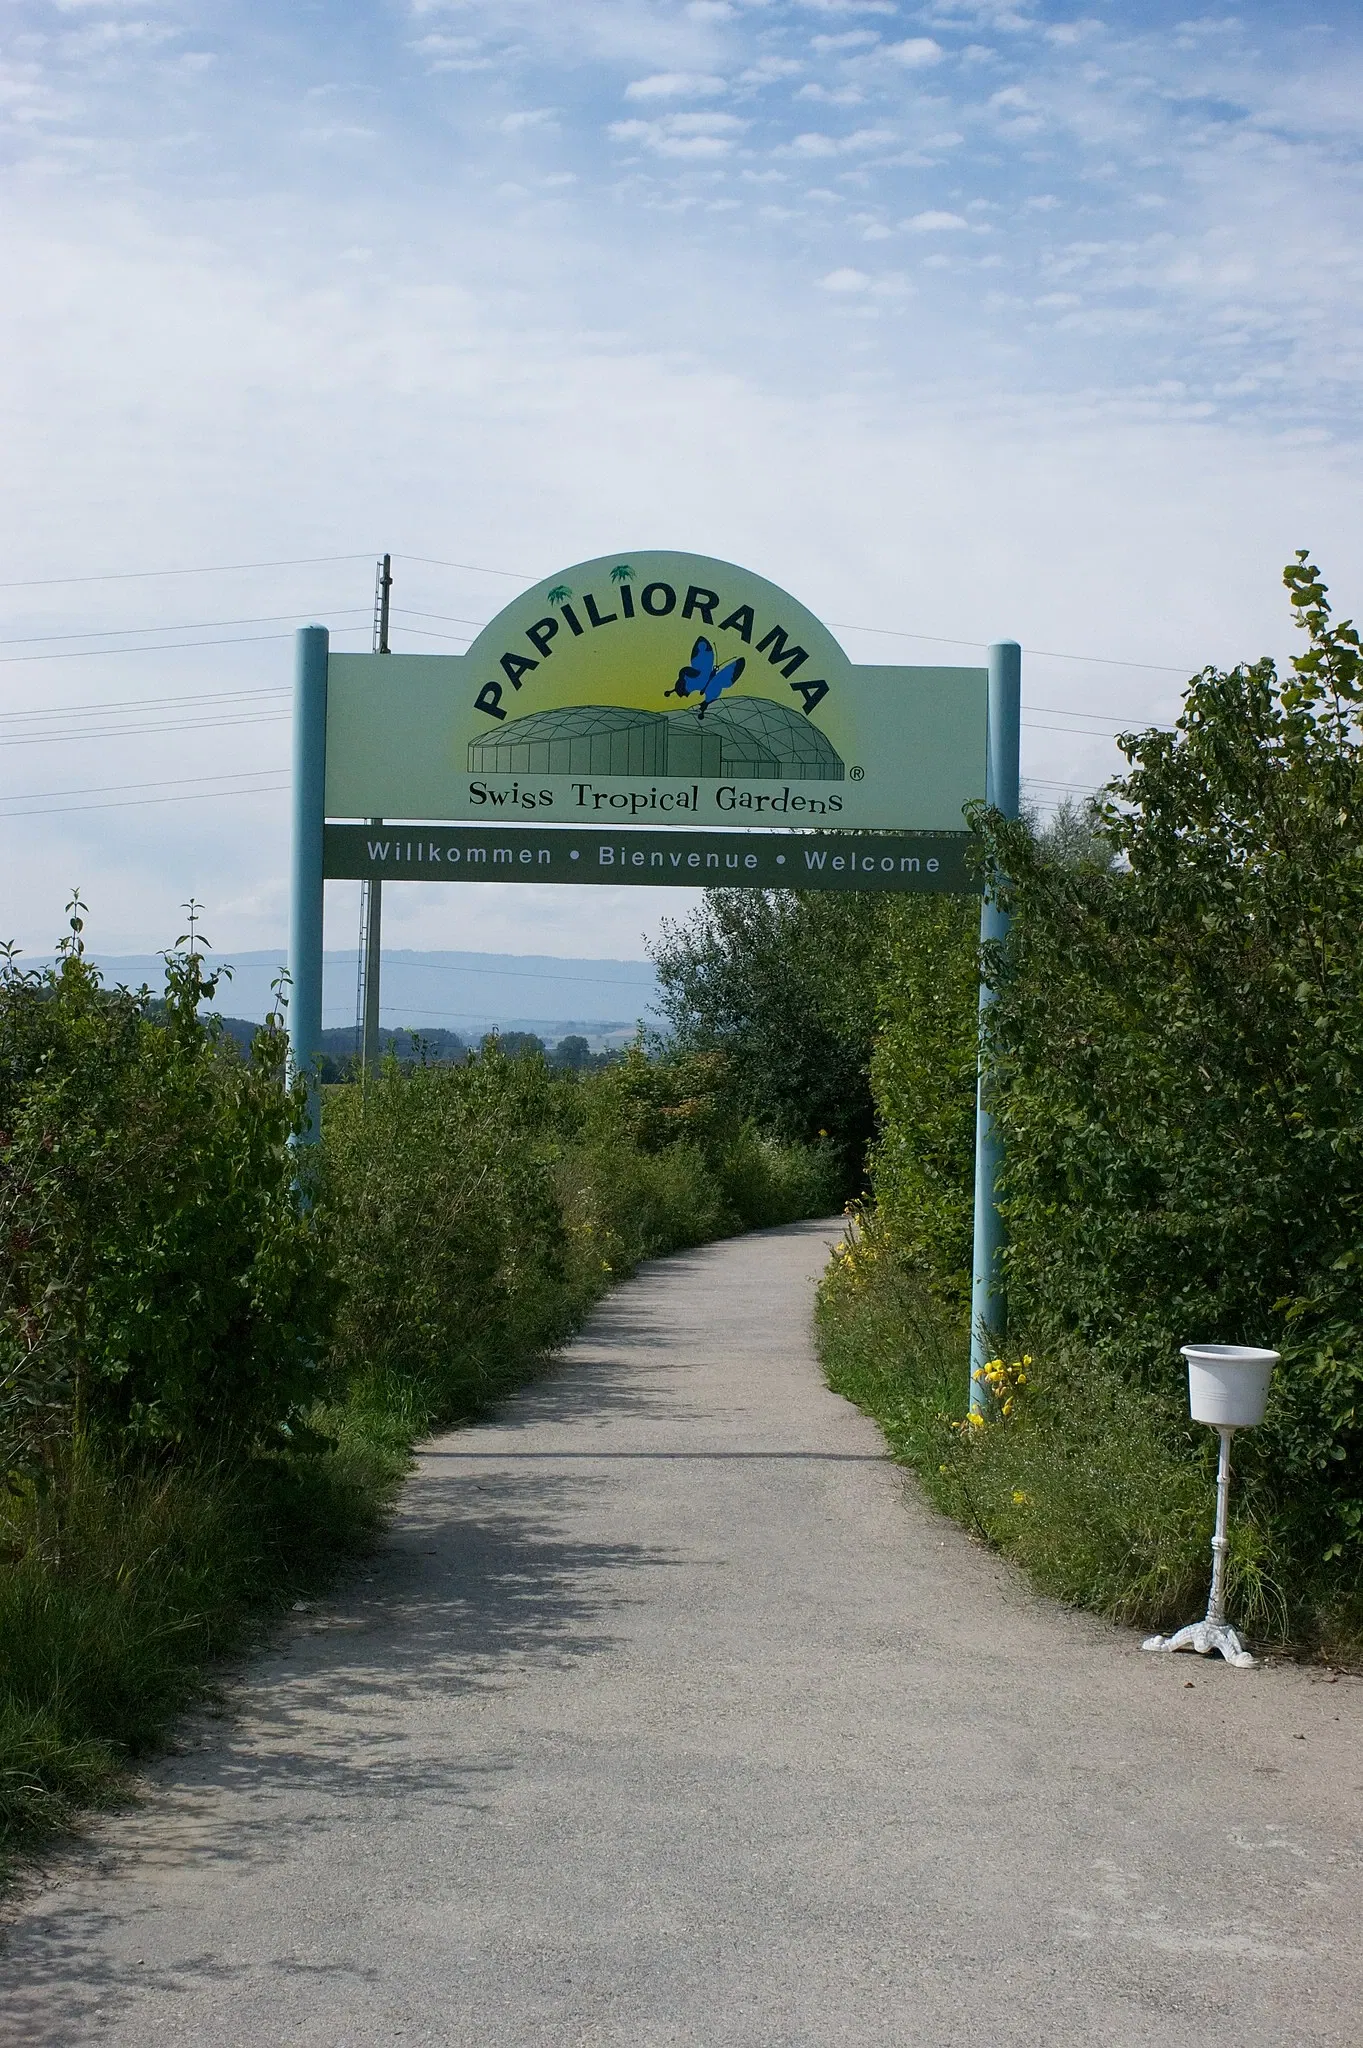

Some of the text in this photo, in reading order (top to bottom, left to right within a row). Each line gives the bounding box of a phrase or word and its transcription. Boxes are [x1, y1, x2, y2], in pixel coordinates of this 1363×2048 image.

[473, 582, 829, 720] PAPILIORAMA
[469, 781, 842, 814] Swiss Tropical Gardens
[367, 841, 940, 872] Willkommen Bienvenue Welcome
